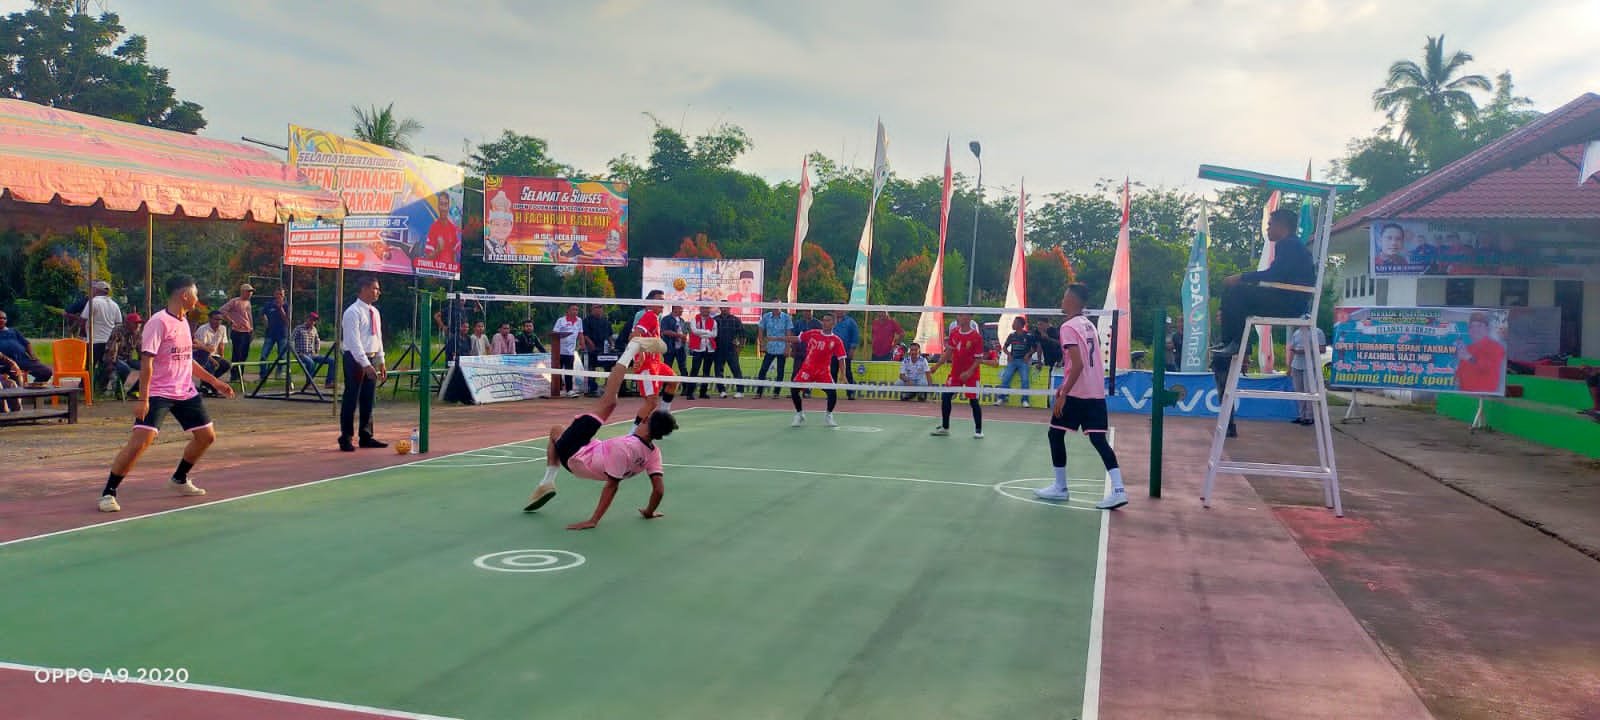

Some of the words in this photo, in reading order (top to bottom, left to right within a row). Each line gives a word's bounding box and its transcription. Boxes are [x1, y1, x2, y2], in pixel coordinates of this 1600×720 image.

[298, 152, 344, 164] SELAMAT
[337, 168, 402, 190] TURNAMEN
[343, 191, 393, 212] TAKRAW
[521, 186, 562, 202] SELAMAT
[561, 193, 569, 203] &
[570, 189, 602, 204] SUKSES
[525, 213, 567, 225] FACHRUL
[1086, 337, 1095, 368] 7
[1187, 326, 1203, 367] Bank
[1335, 342, 1354, 351] OPEN
[1396, 344, 1421, 353] SEPAK
[1423, 345, 1457, 354] TAKRAW
[1398, 352, 1416, 361] RAZI
[1120, 386, 1240, 413] vvo
